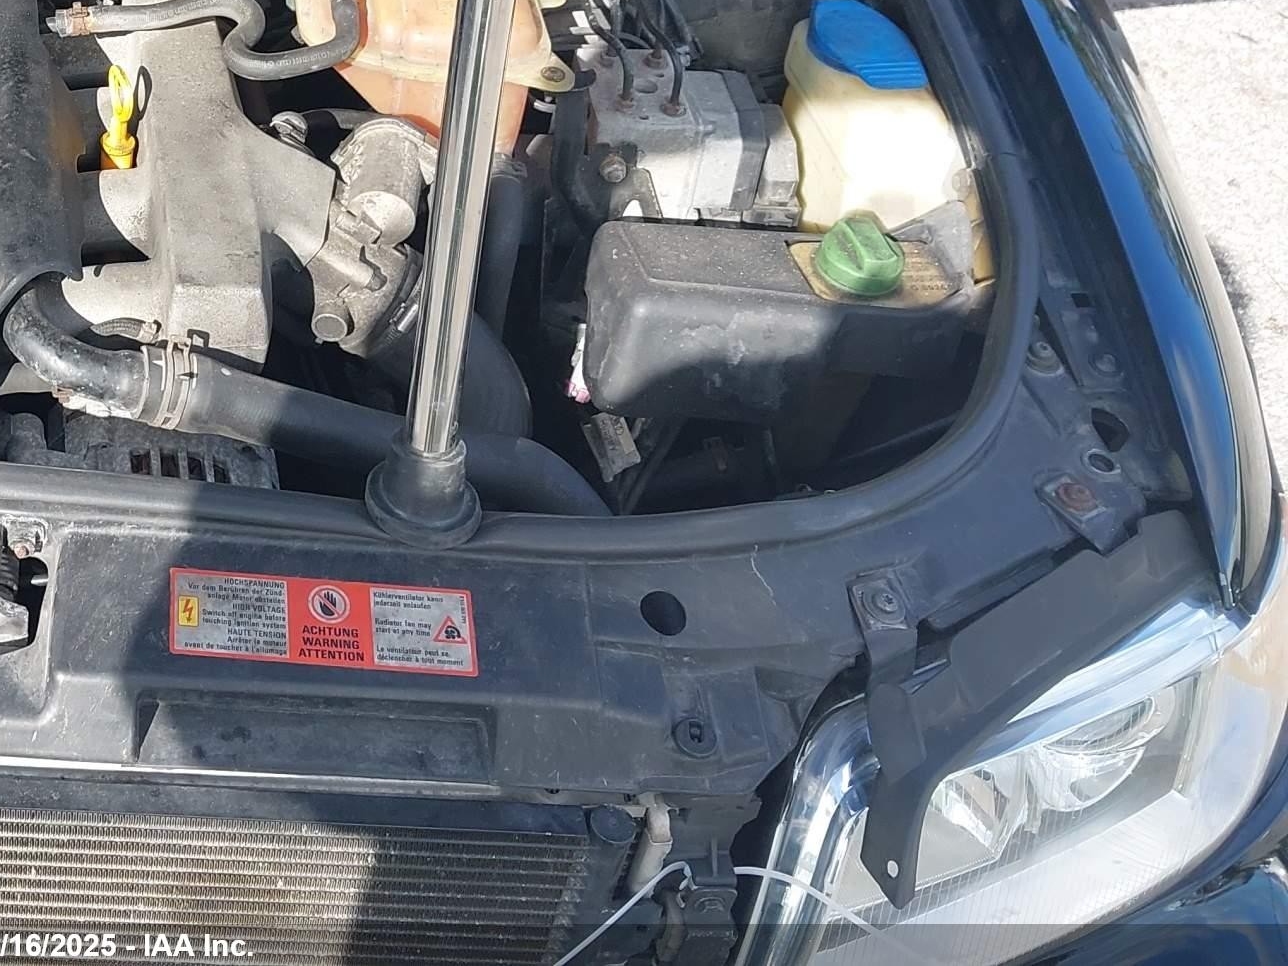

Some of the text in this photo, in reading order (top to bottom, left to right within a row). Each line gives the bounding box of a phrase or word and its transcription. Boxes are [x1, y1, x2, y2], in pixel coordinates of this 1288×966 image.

[225, 578, 284, 588] HOCHSPANNUNG
[233, 603, 285, 613] HIGH VOLTAGE
[202, 617, 231, 626] touching
[262, 620, 286, 629] system
[375, 618, 402, 626] Radiator
[228, 628, 286, 638] HAUTE TENSION
[303, 625, 359, 638] ACHTUNG
[302, 637, 359, 649] WARNING
[299, 648, 364, 661] ATTENTION
